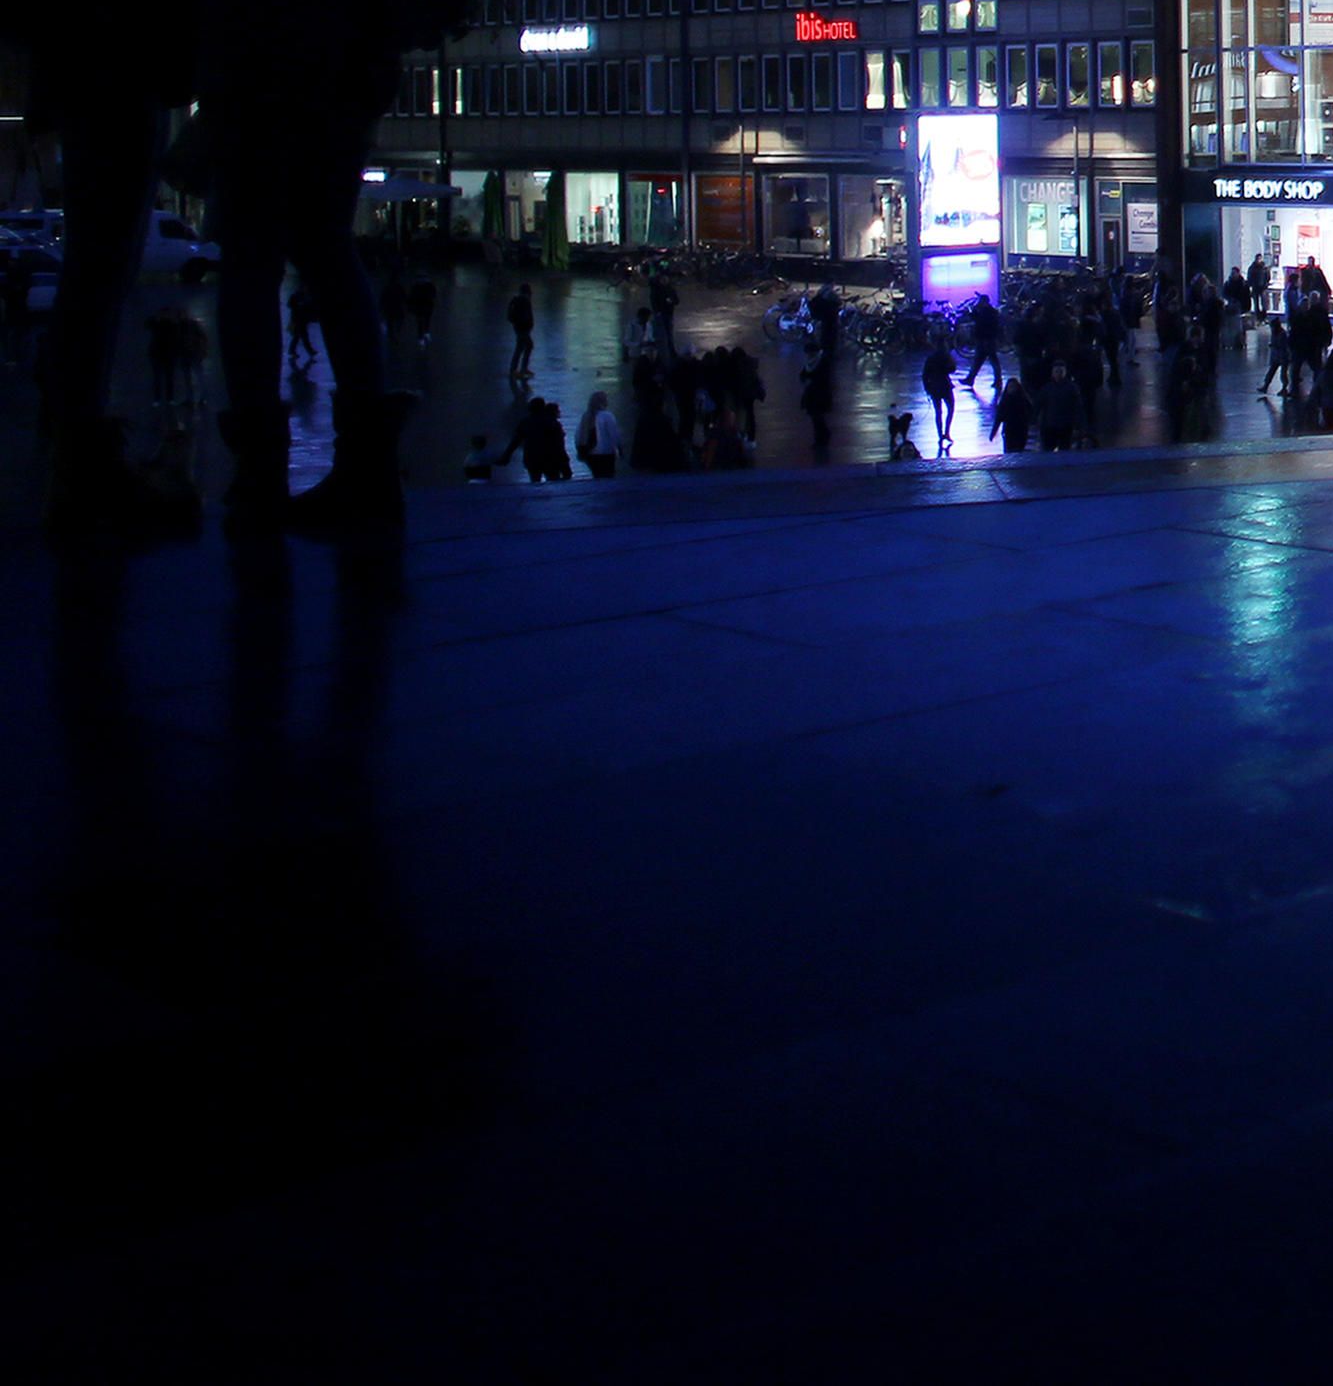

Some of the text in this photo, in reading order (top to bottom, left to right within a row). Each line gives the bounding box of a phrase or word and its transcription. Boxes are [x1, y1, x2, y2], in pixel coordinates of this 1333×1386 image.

[795, 12, 857, 41] ibis HOTEL
[1213, 179, 1324, 202] THE BODY SHOP
